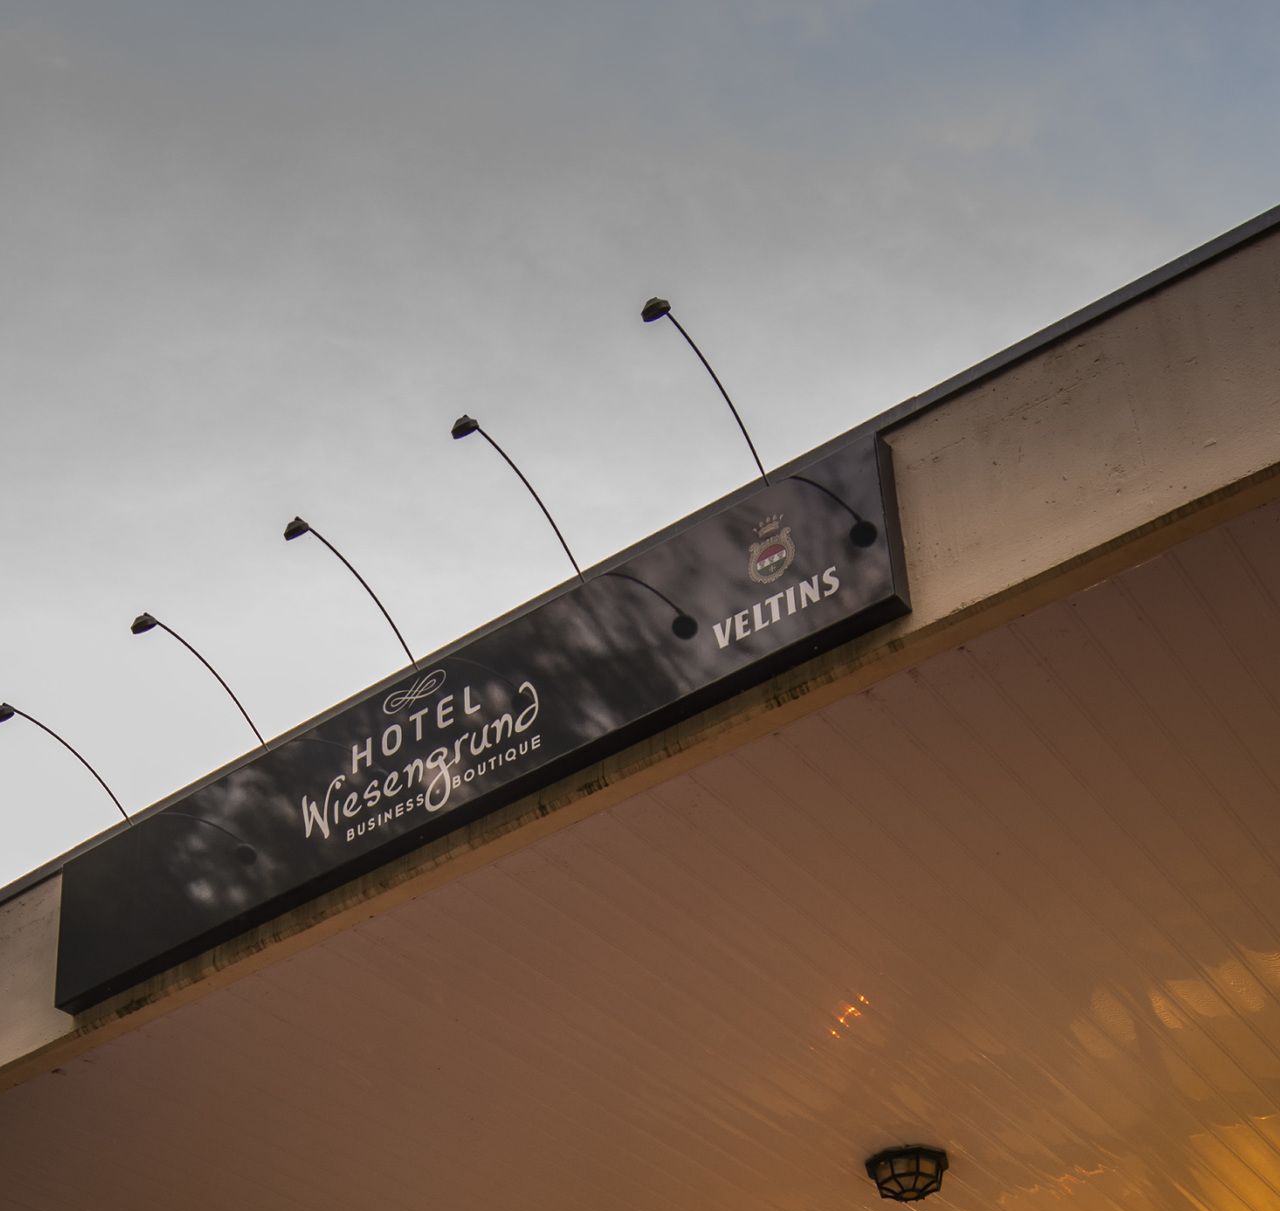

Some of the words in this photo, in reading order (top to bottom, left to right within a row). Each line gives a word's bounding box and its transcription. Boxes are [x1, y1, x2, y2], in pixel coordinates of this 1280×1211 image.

[712, 566, 840, 649] VELTINS
[302, 681, 539, 838] Wiesengrund
[351, 686, 481, 774] HOTEL
[346, 794, 424, 841] BUSINESS
[452, 735, 542, 789] BOUTIQUE
